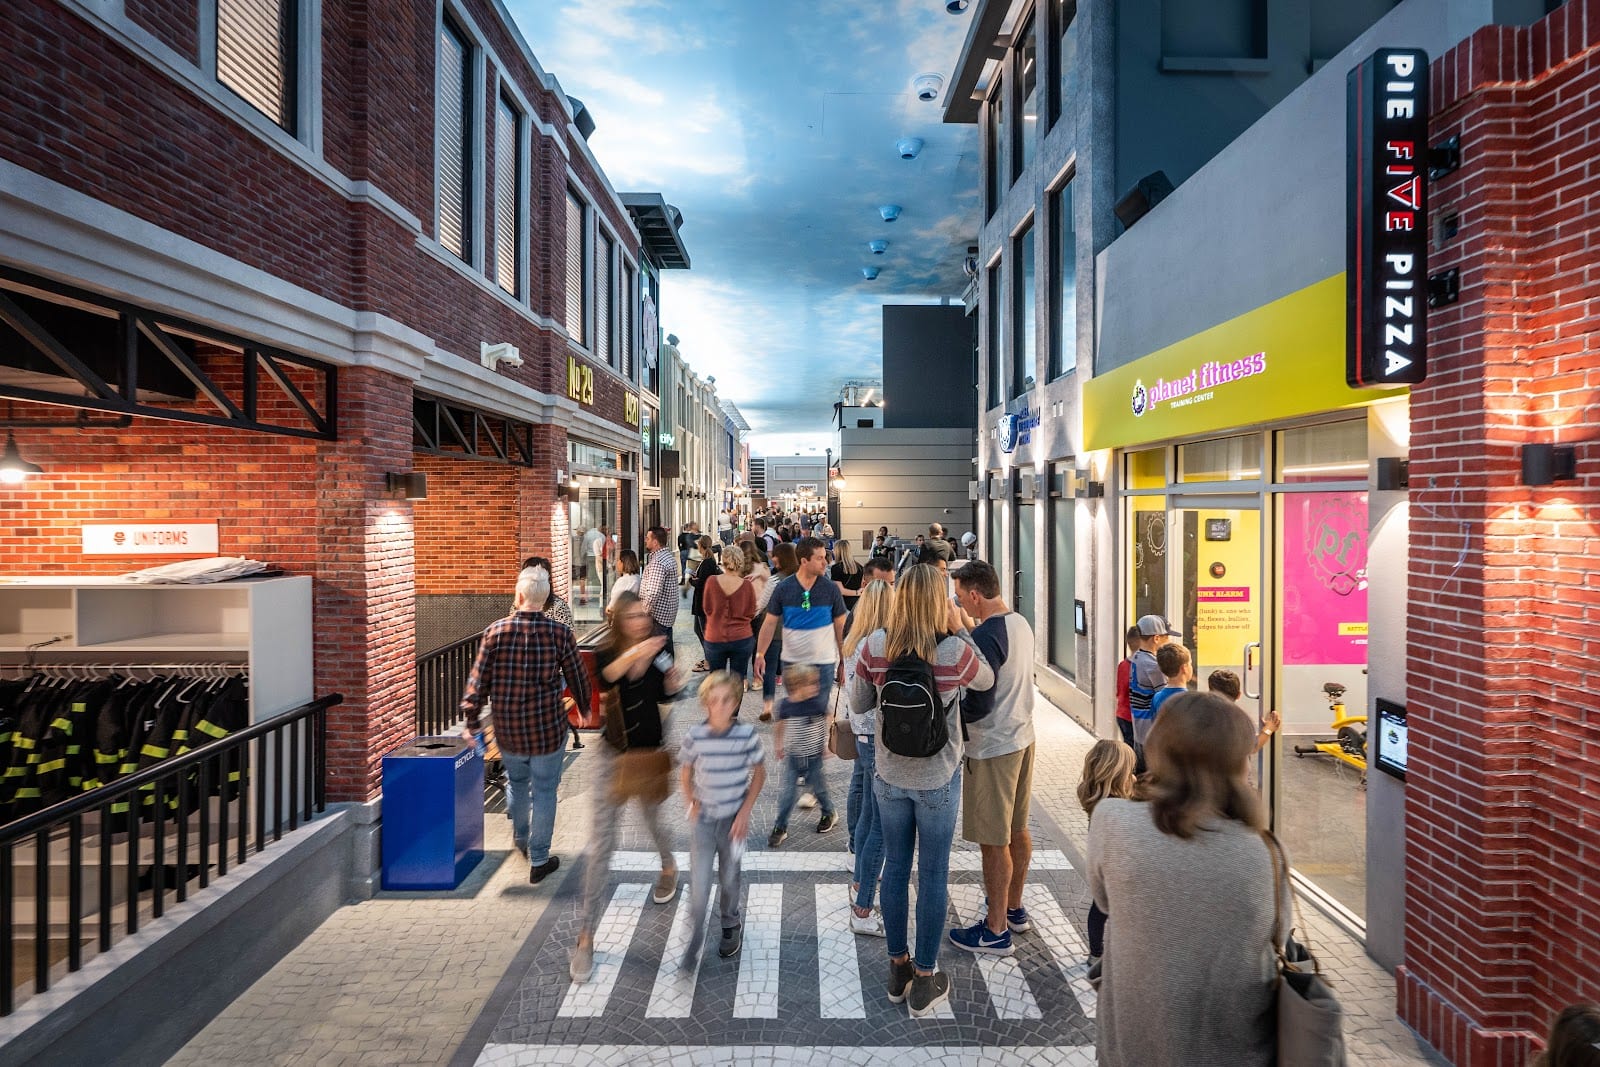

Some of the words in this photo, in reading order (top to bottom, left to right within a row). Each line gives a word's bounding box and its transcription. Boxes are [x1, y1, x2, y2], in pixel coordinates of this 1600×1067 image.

[1386, 54, 1415, 119] PIE
[1386, 140, 1421, 231] FIVE
[1385, 254, 1413, 376] PIZZA
[580, 364, 594, 406] 29
[1149, 369, 1197, 411] planet
[1200, 351, 1267, 390] fitness
[1170, 396, 1193, 409] TRAINING
[1193, 391, 1214, 403] CENTER
[642, 432, 675, 447] Stify
[134, 531, 188, 545] UNIFORMS
[454, 748, 475, 770] RECYCLE
